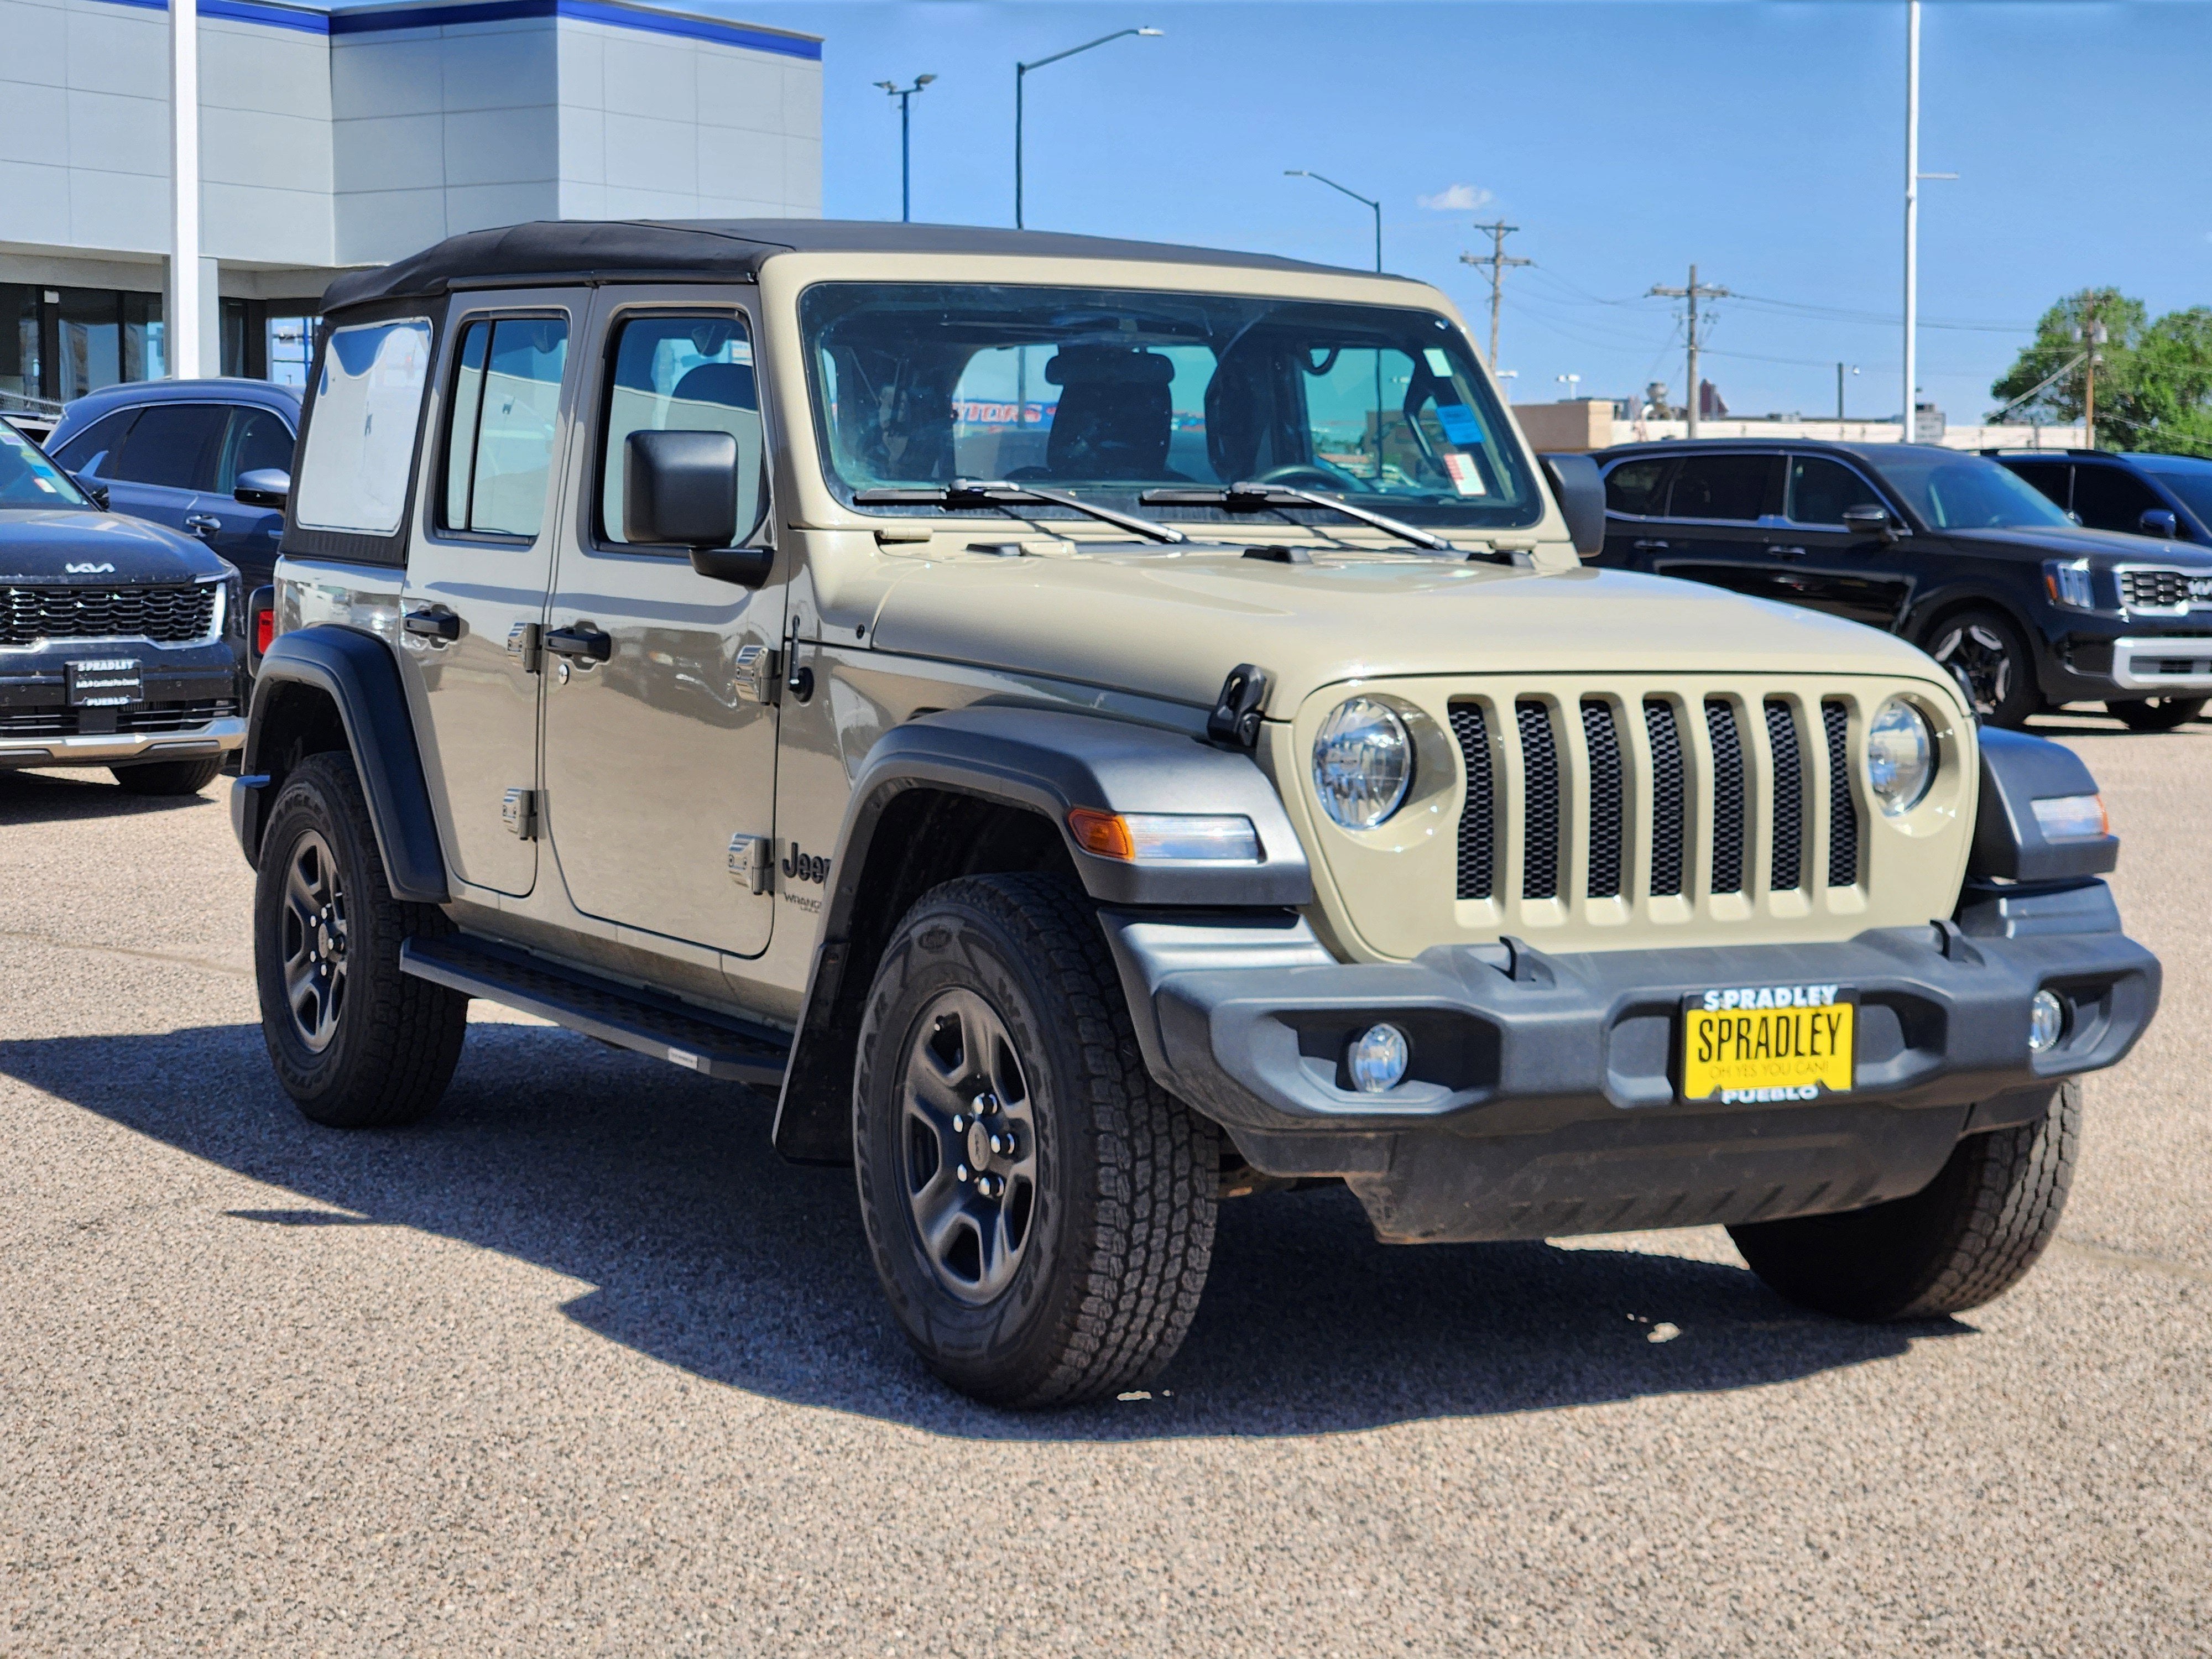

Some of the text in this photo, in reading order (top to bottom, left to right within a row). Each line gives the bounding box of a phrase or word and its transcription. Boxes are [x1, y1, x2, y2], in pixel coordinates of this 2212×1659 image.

[77, 659, 134, 671] SPRADLEY
[86, 697, 129, 706] PUEBLO
[1704, 985, 1838, 1011] SPRADLEY
[1698, 1013, 1841, 1063] SPRADLEY
[1735, 1064, 1757, 1078] YES
[1762, 1062, 1791, 1077] YOU
[1721, 1084, 1819, 1105] PUEBLO
